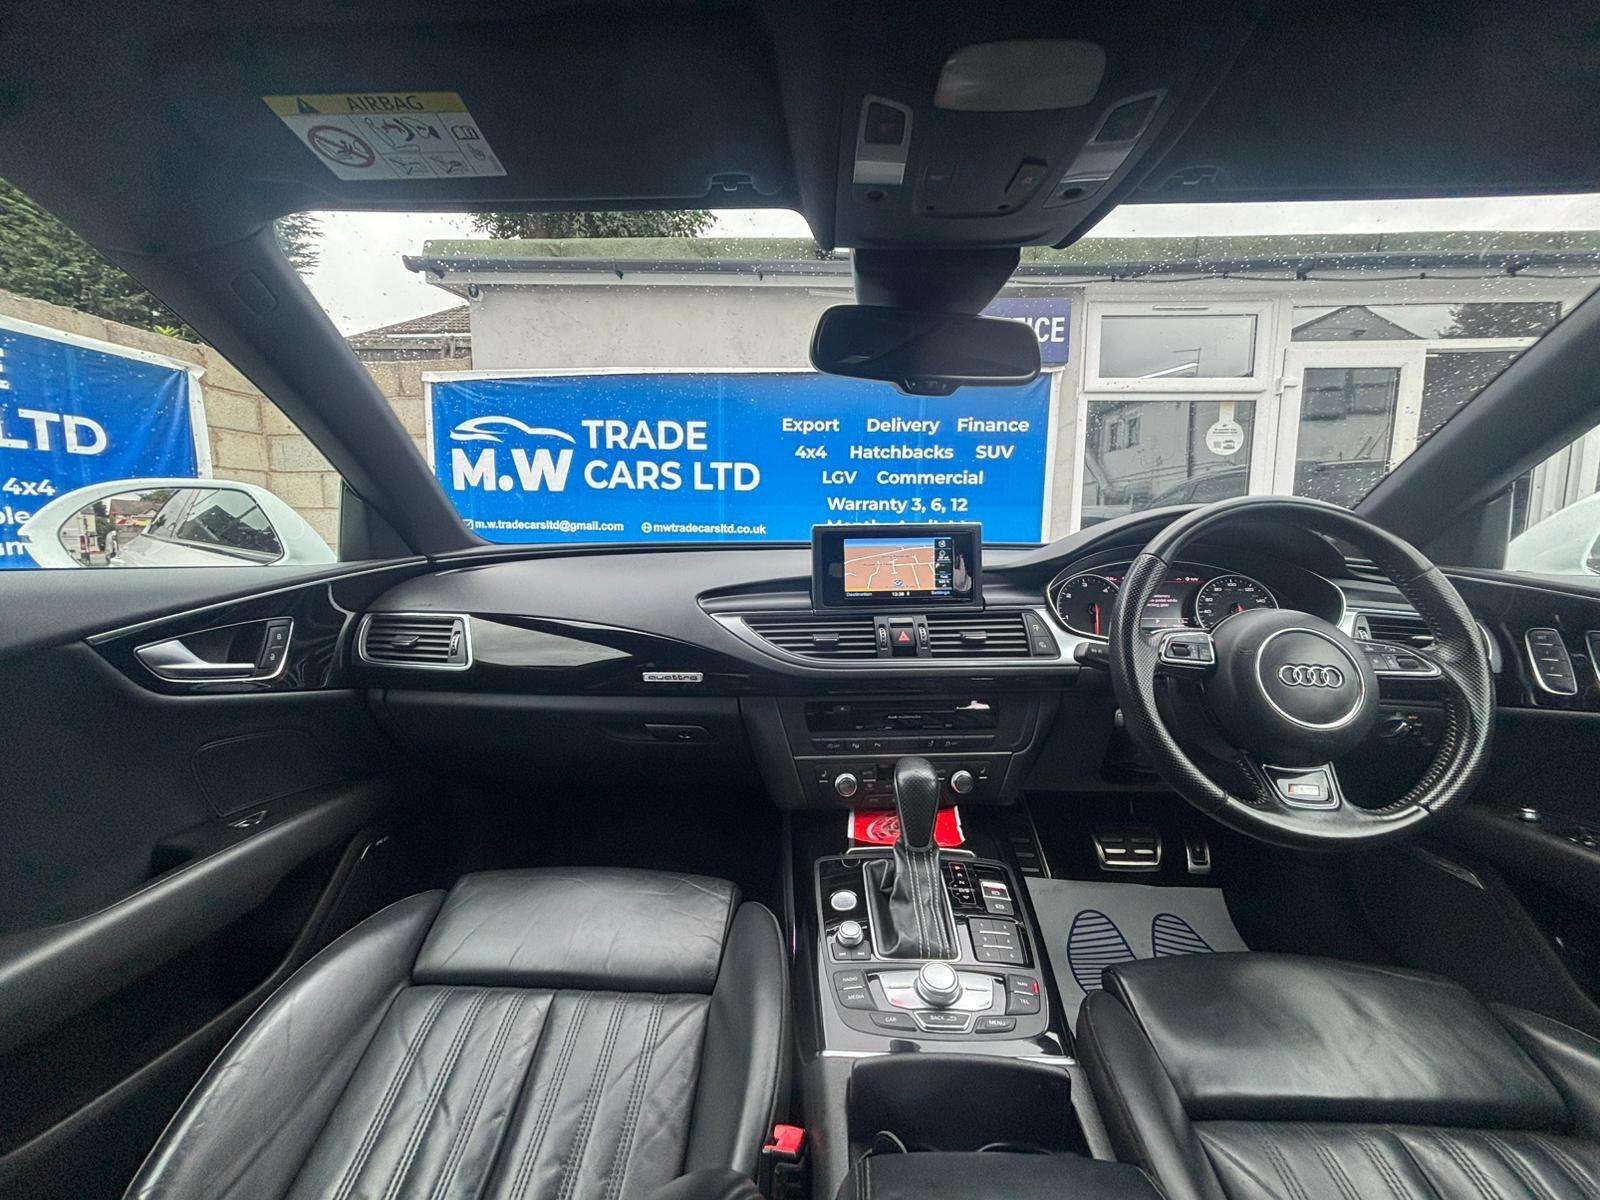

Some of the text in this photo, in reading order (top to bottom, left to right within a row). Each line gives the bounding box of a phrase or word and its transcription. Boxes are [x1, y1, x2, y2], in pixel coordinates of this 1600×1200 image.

[346, 95, 425, 112] AIRBAG
[582, 419, 708, 451] TRADE
[782, 418, 1030, 435] Export Delivery Finance
[795, 444, 1015, 459] 4x4 Hatchbacks SUV
[451, 448, 574, 492] M.W
[584, 459, 761, 491] CARS LTD
[822, 469, 984, 485] LGV Commercial
[2, 477, 56, 496] 4x4
[827, 497, 968, 515] Warranty 3, 6, 12
[475, 519, 624, 532] m.w.tradecarsltd@gmail.com
[653, 523, 767, 535] mwtradecarsltd.co.uk
